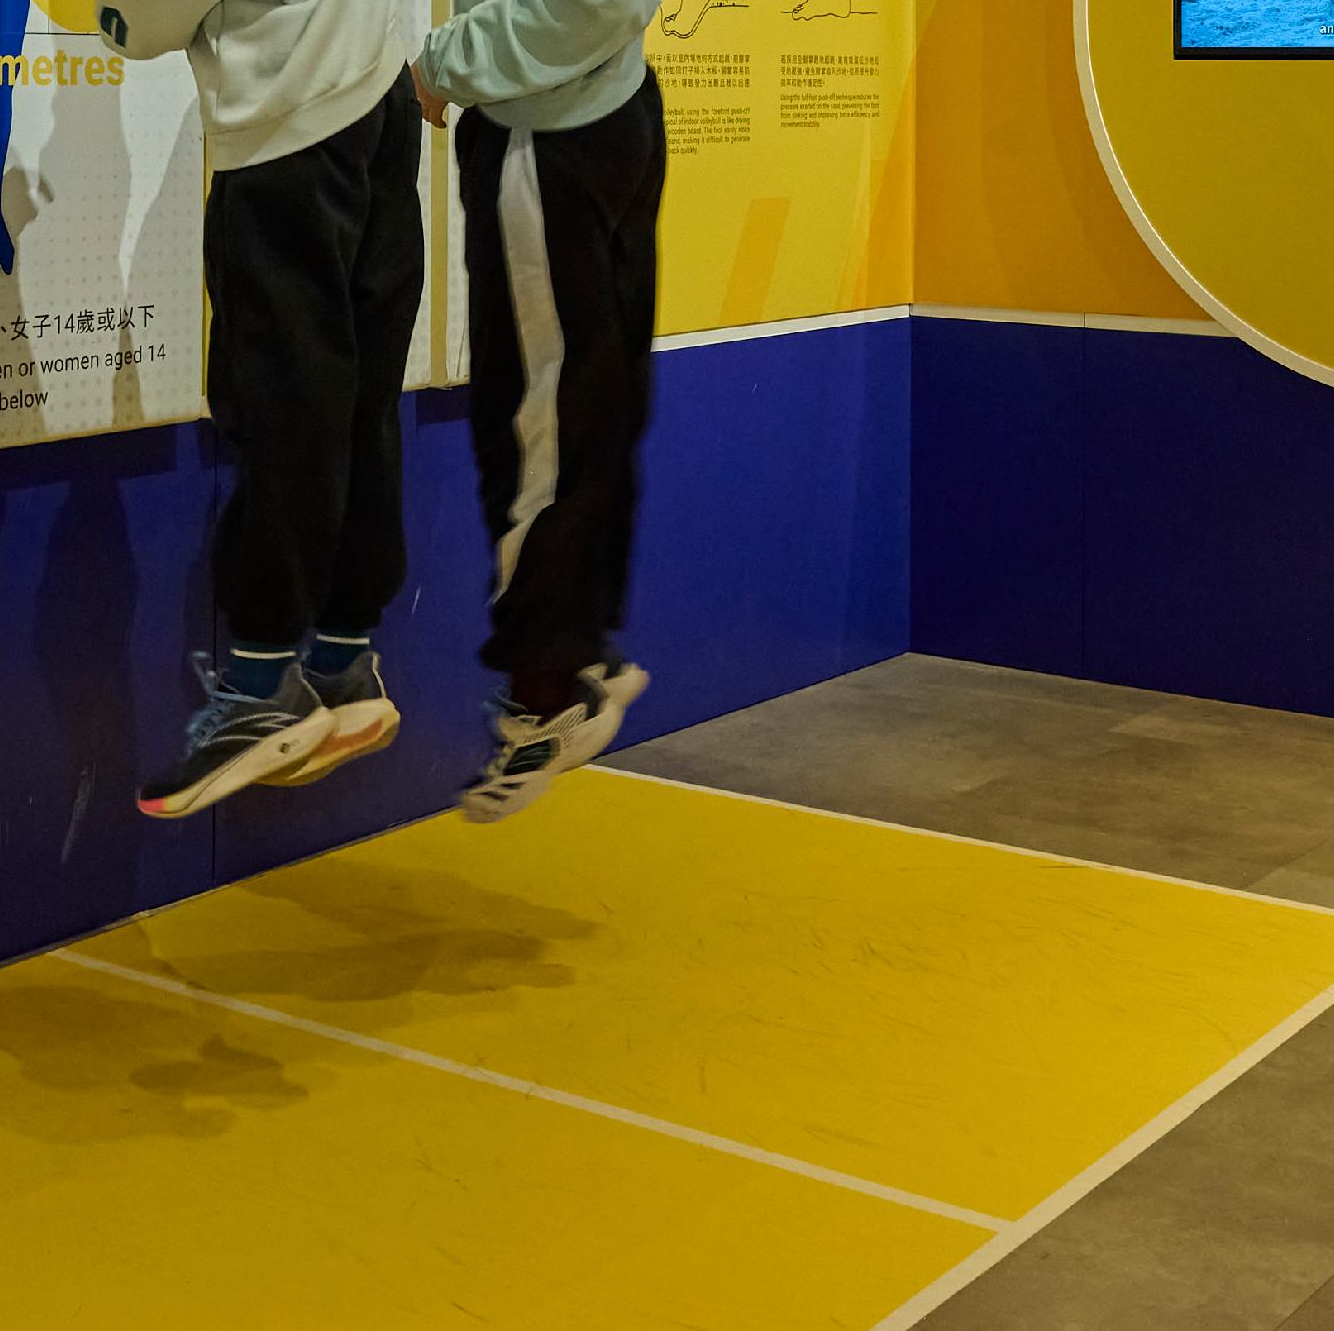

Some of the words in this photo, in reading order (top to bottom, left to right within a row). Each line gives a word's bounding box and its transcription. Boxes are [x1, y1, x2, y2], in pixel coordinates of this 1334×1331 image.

[17, 359, 35, 379] or
[39, 354, 99, 373] women
[104, 343, 141, 375] aged
[147, 343, 166, 361] 14
